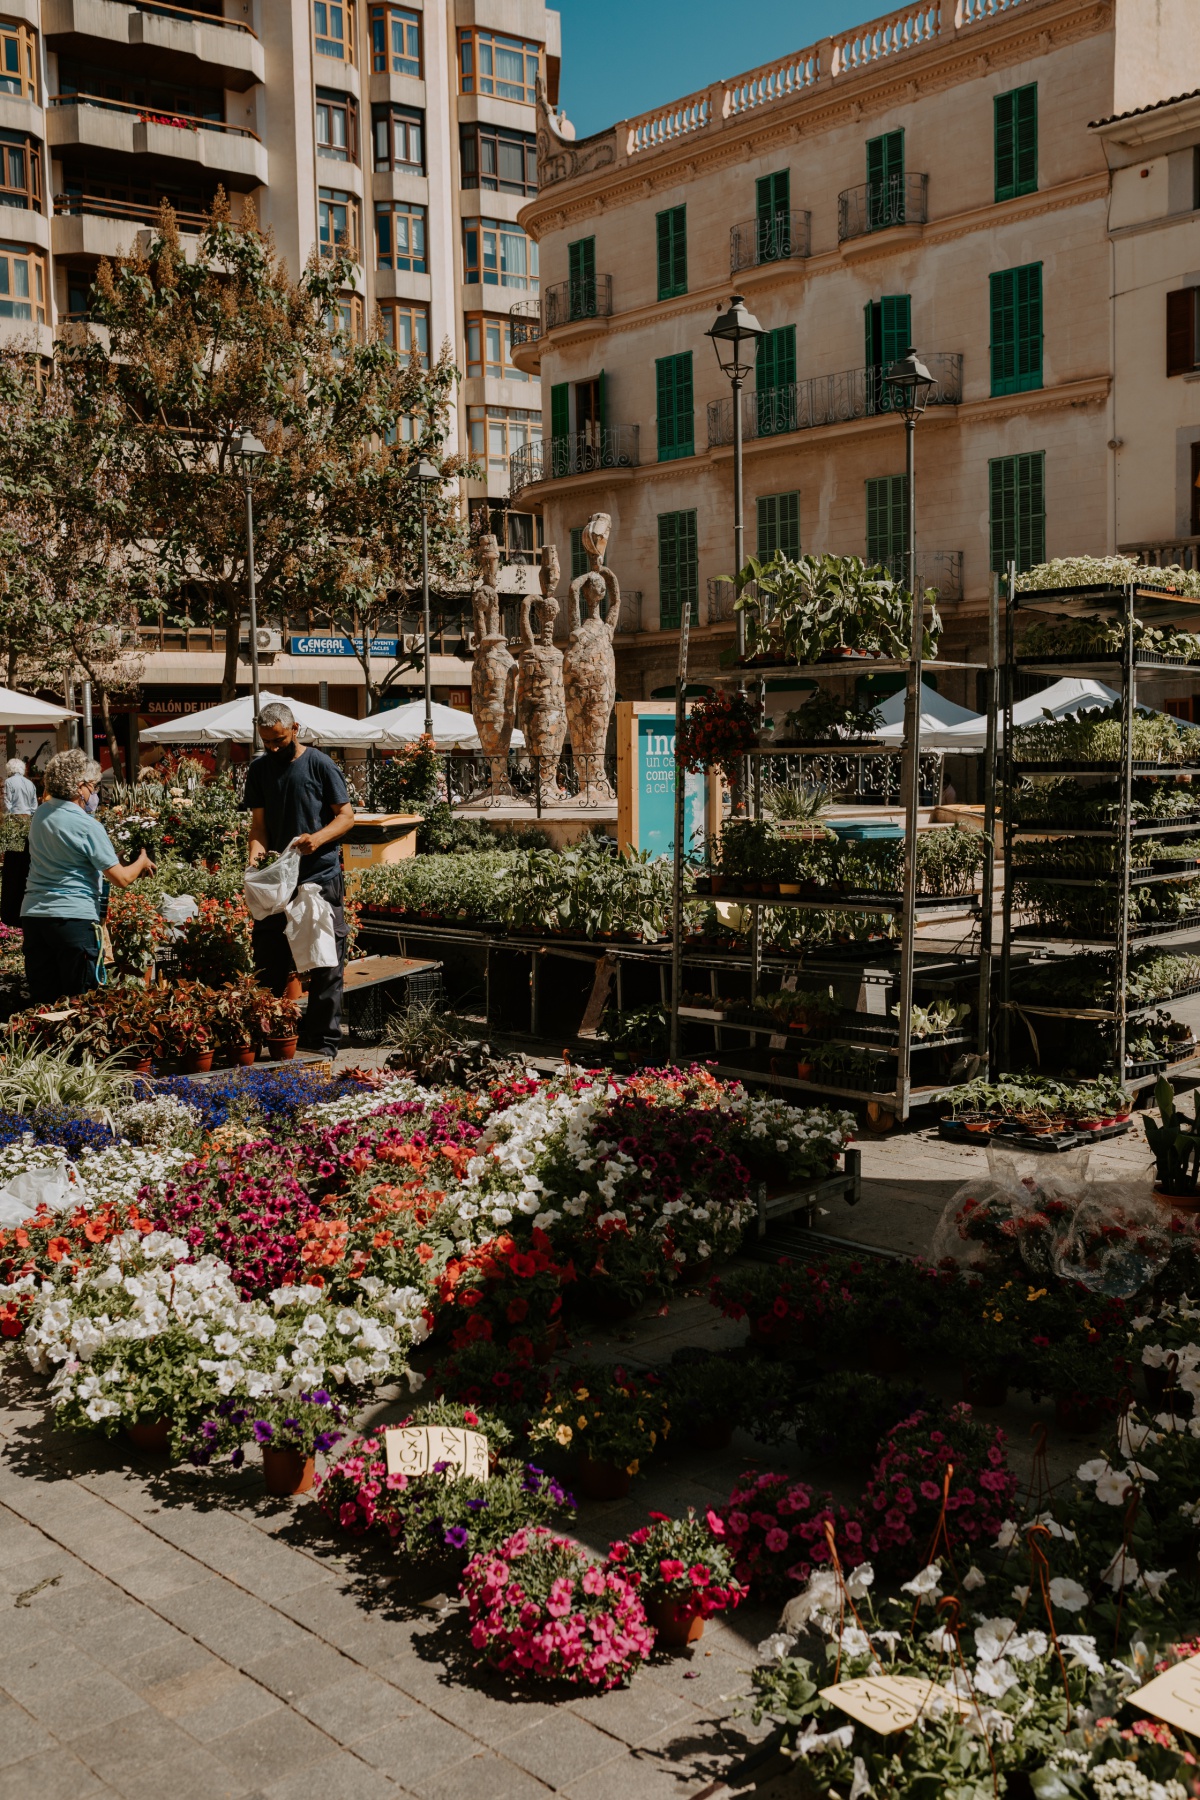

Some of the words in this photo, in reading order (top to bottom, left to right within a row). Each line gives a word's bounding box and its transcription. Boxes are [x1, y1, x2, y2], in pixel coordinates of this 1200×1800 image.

[148, 699, 181, 713] SALÓN
[184, 702, 198, 713] DE
[646, 757, 660, 767] un
[646, 783, 652, 793] a
[654, 779, 669, 793] cel
